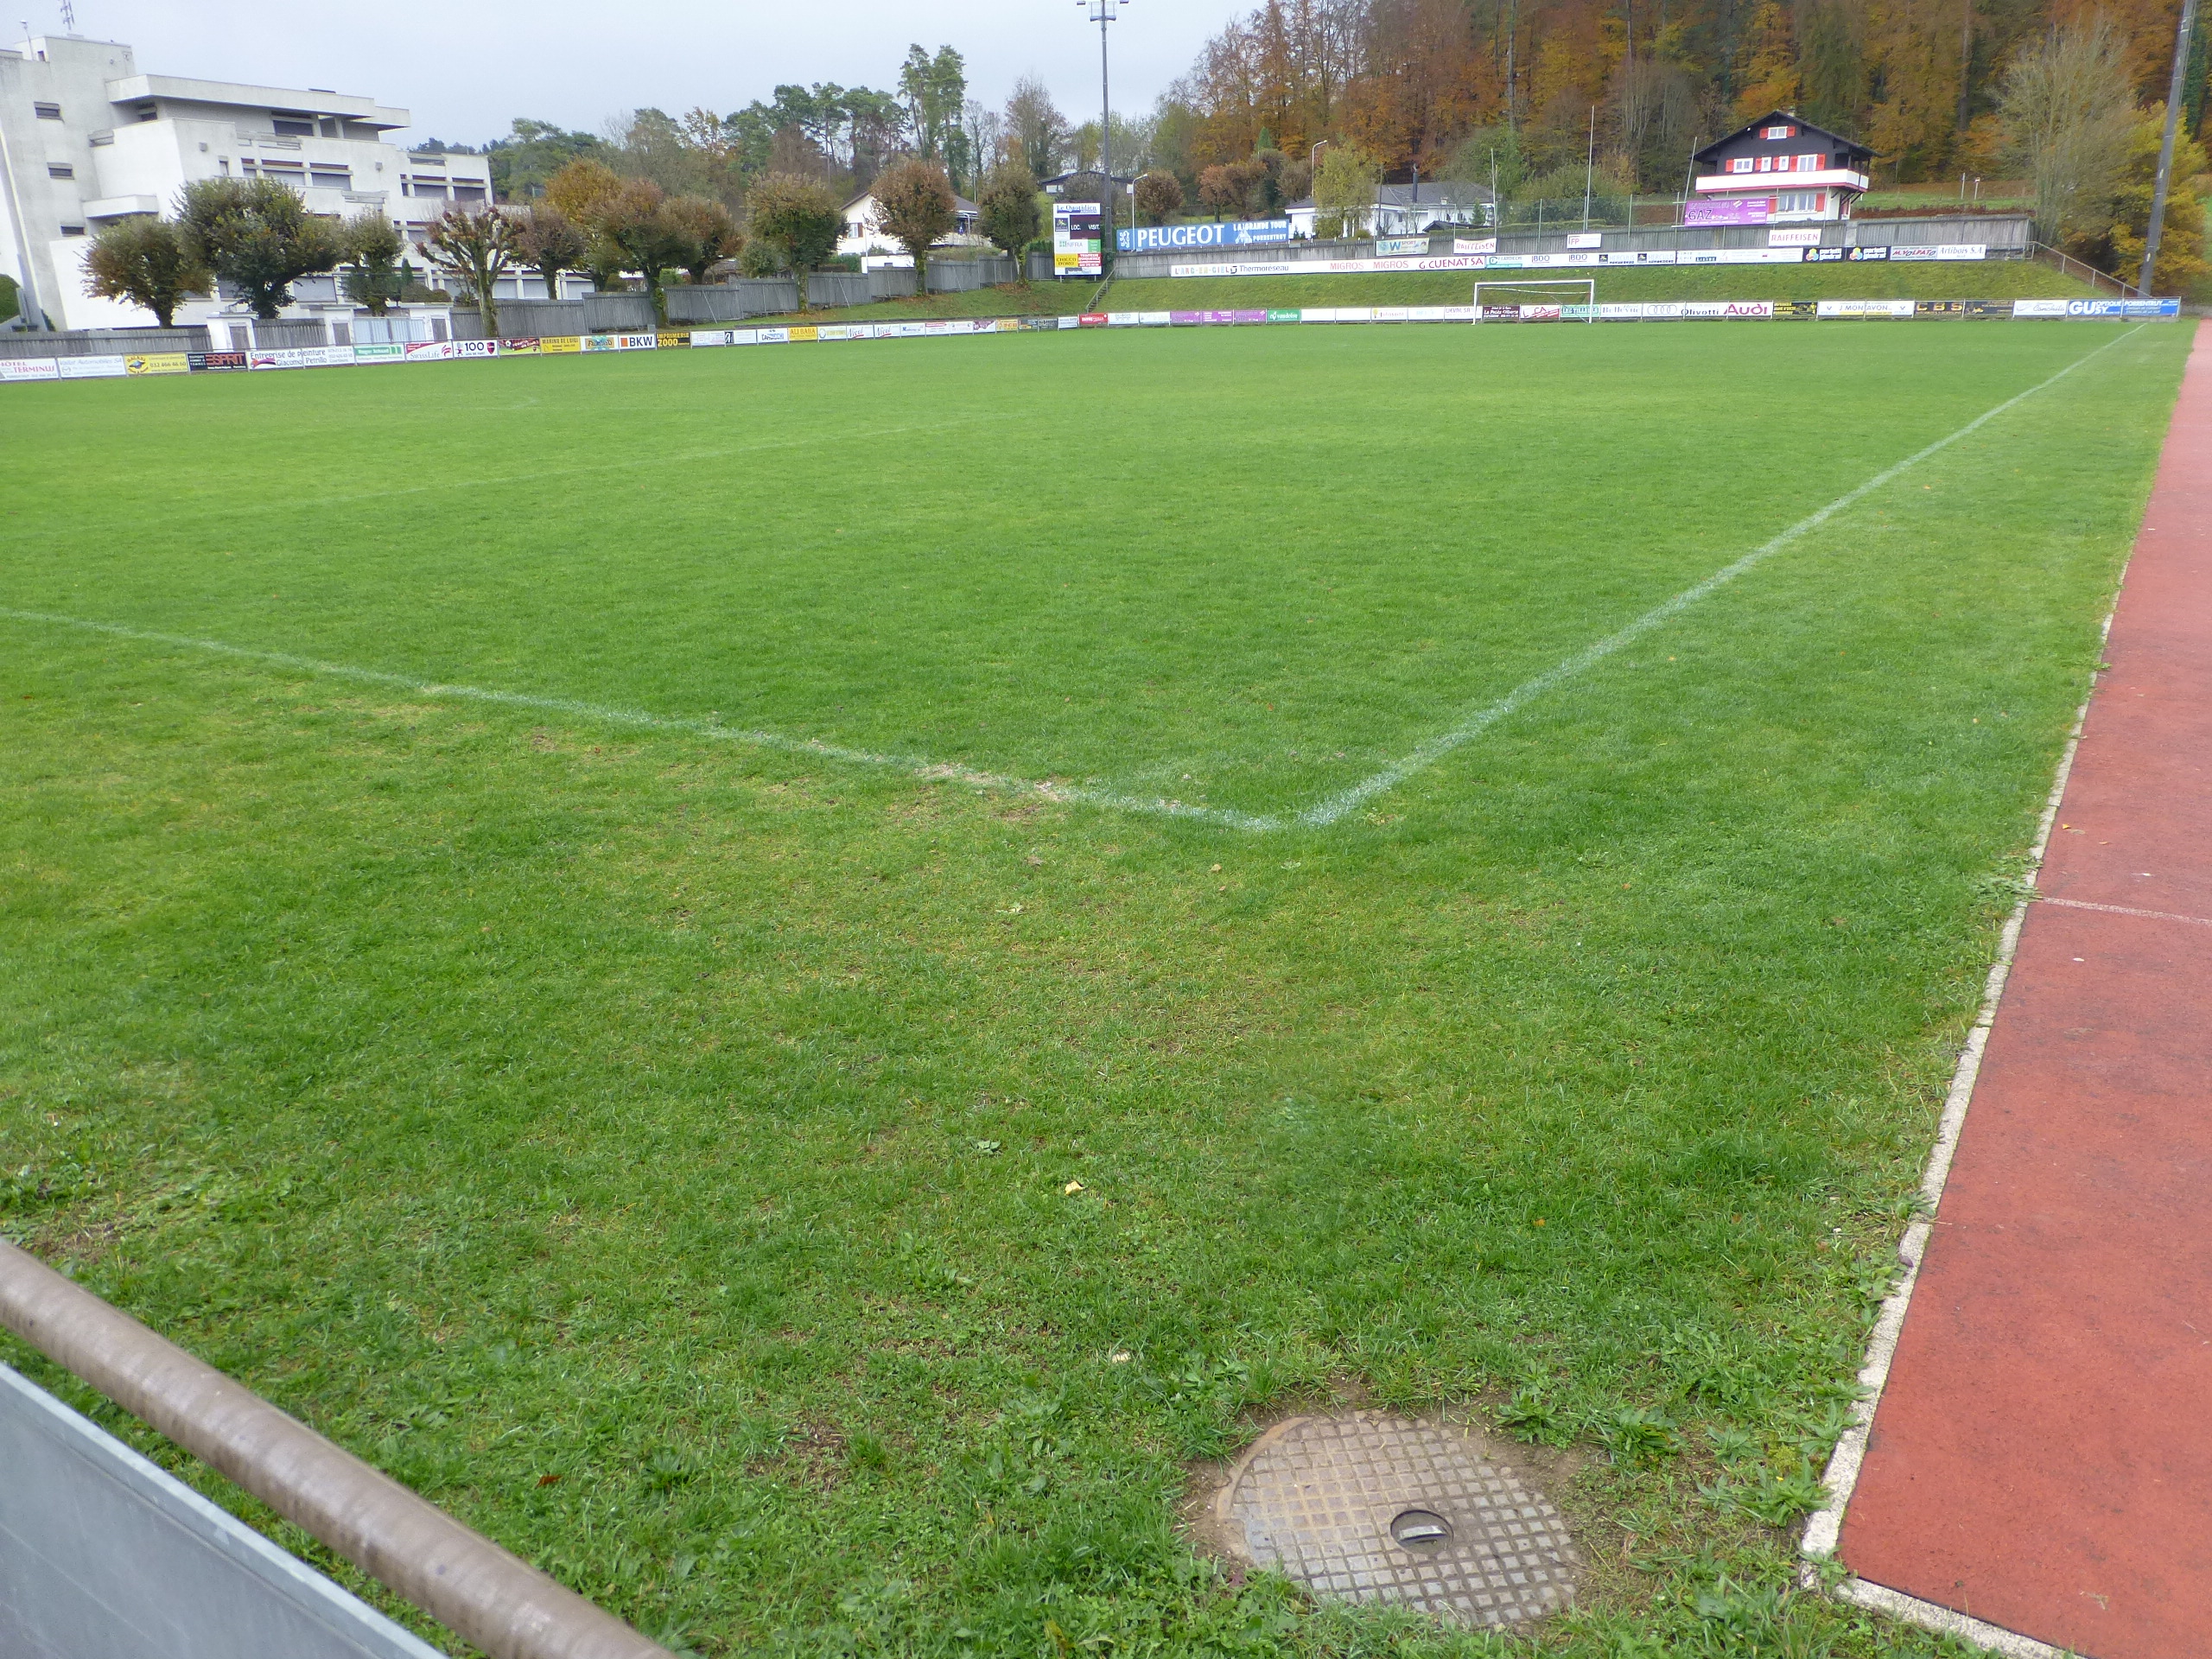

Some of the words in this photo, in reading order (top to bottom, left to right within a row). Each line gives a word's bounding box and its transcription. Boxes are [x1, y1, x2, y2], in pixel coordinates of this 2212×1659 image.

[1065, 204, 1096, 213] Quotidien
[1688, 209, 1712, 221] GAZ
[1137, 225, 1225, 248] PEUGEOT
[1771, 233, 1819, 242] RAIFFEISEN
[1389, 242, 1402, 251] W
[1330, 262, 1364, 270] MIGROS
[1373, 260, 1409, 270] MIGROS
[1471, 257, 1484, 266] SA
[1723, 303, 1768, 315] Audi
[464, 341, 485, 352] 100
[629, 336, 653, 347] BKW
[205, 353, 245, 365] ESPRIT
[250, 351, 286, 360] Entreprise
[288, 349, 296, 358] de
[276, 359, 302, 367] Giacomo
